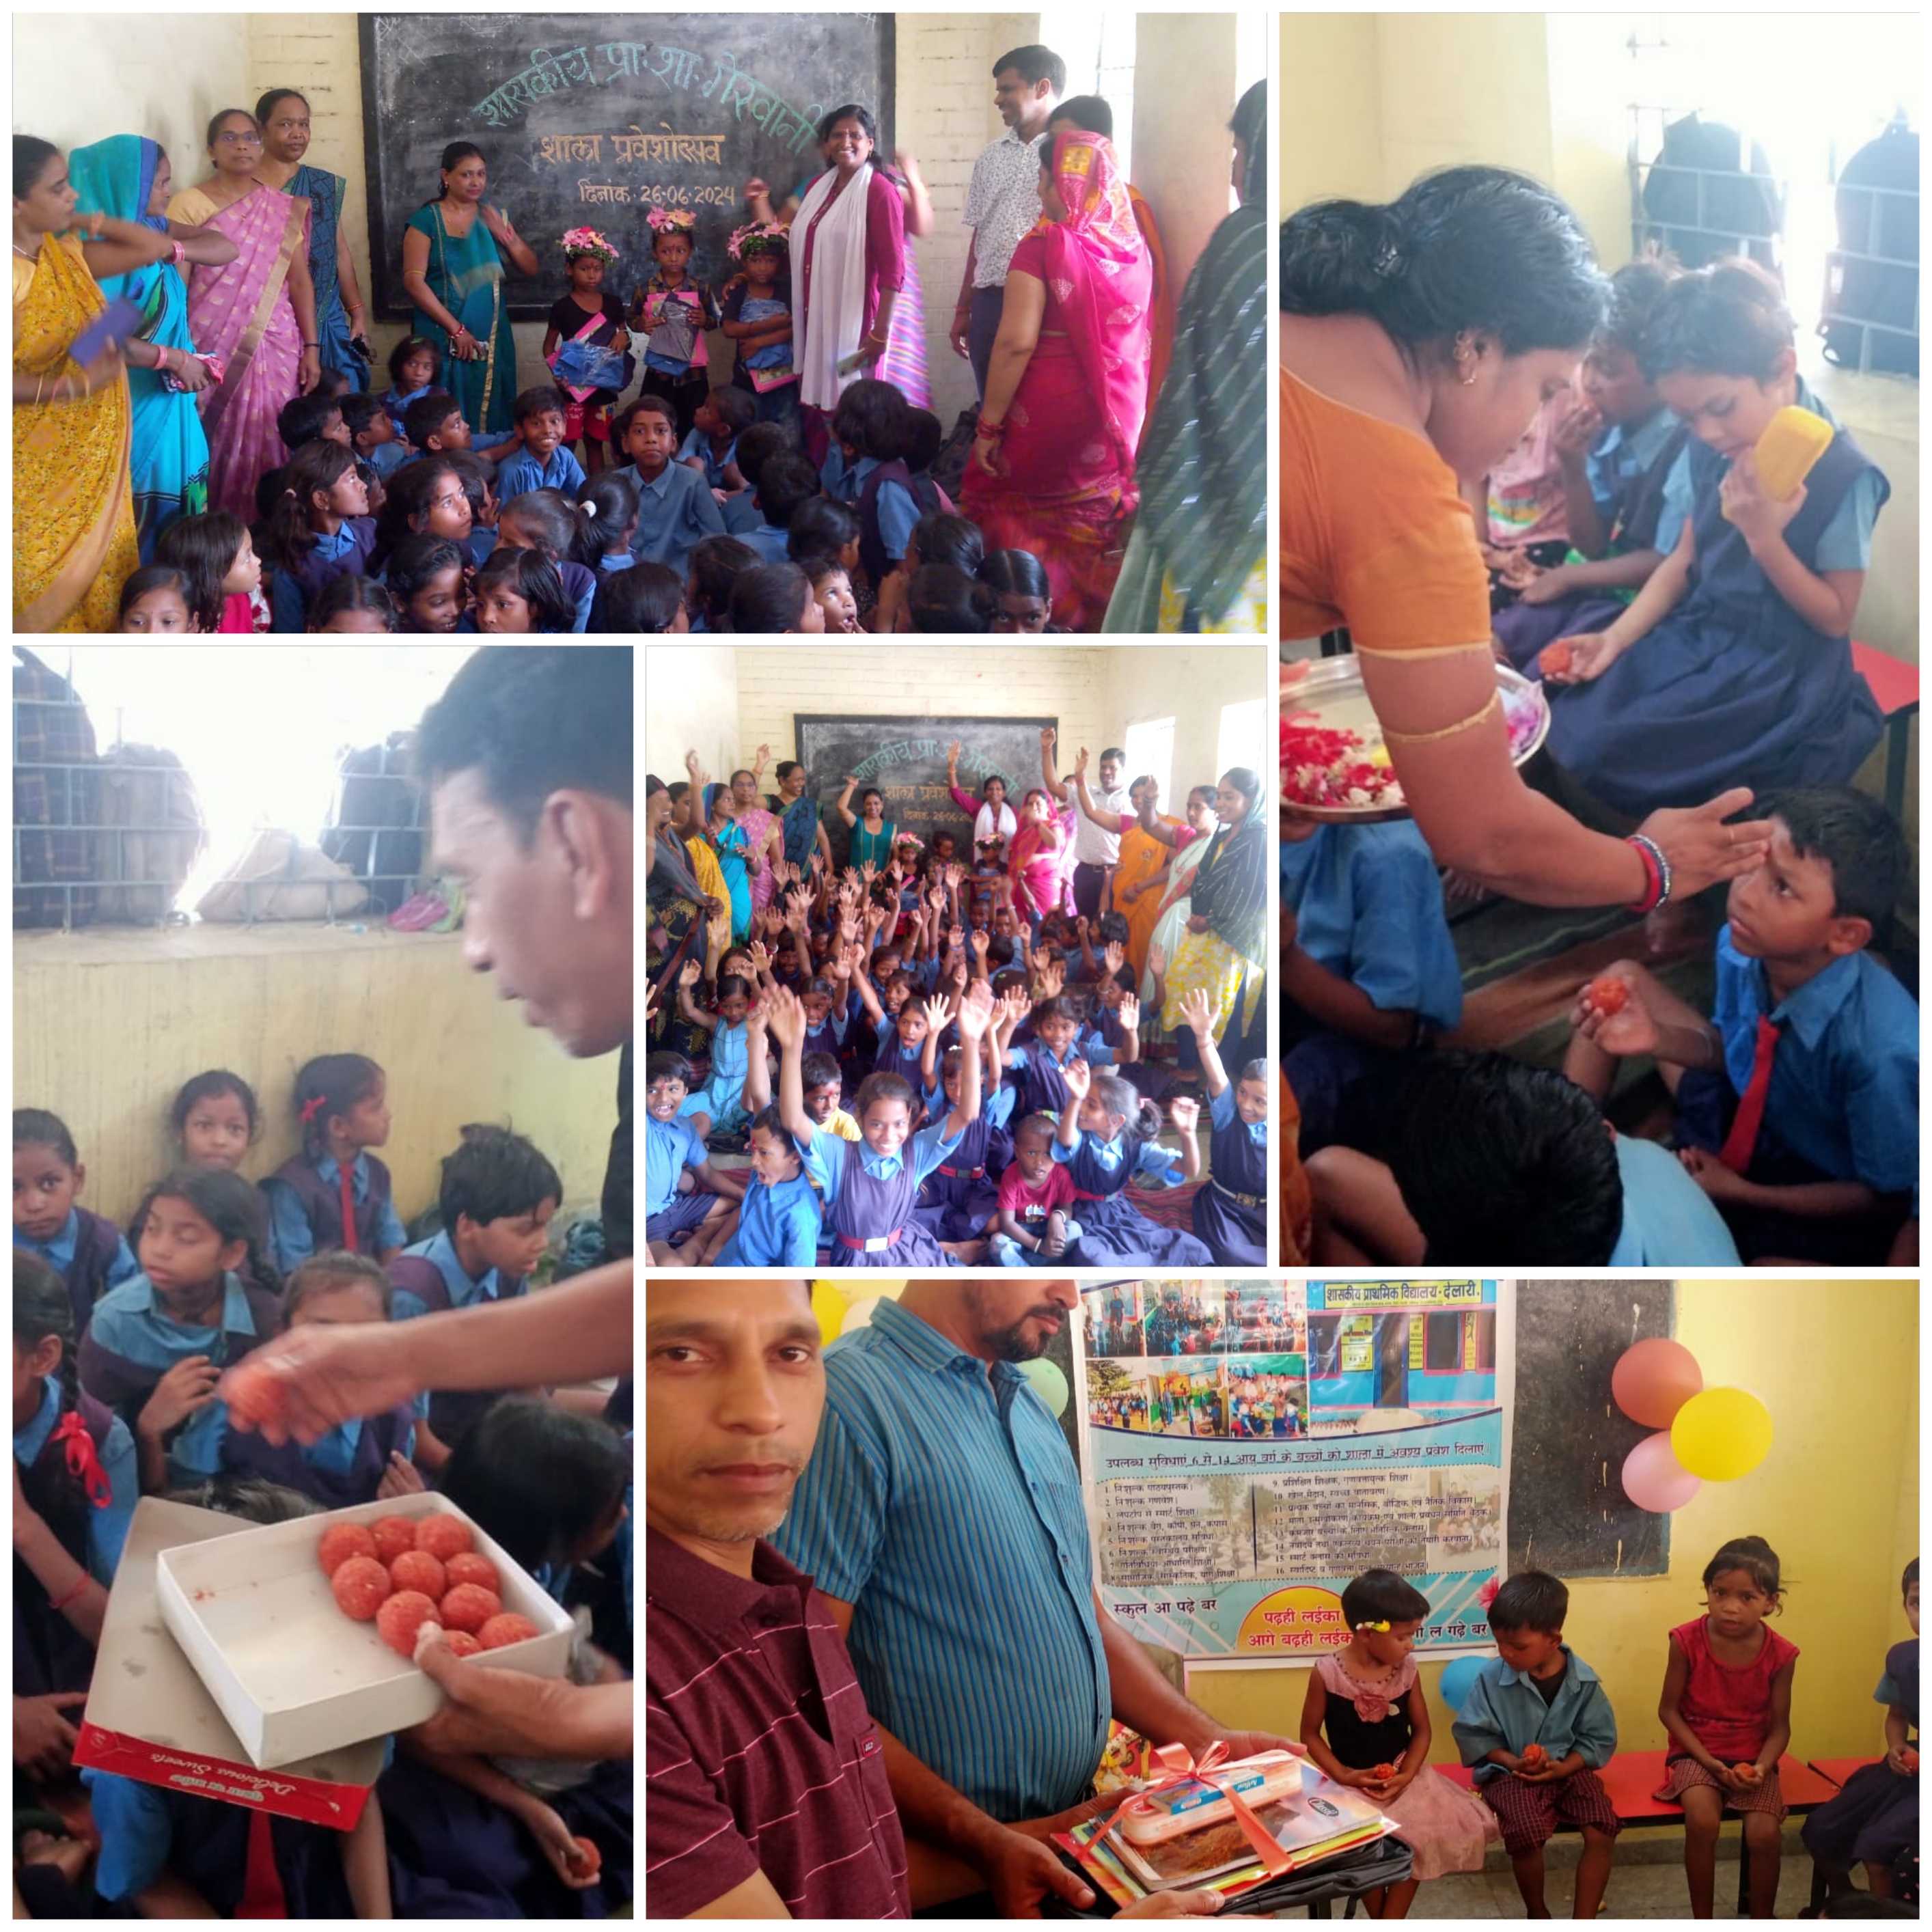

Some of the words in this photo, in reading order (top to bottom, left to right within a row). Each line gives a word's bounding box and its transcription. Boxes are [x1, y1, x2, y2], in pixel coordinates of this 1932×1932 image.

[470, 47, 596, 127] शासकीय
[540, 135, 603, 165] शाला
[611, 122, 726, 165] प्रवेशोत्सव
[885, 786, 916, 801] शाला
[1327, 1284, 1360, 1301] शासकीय
[1364, 1282, 1398, 1300] प्राथमिक
[1105, 1458, 1143, 1468] उपलब्ध
[1148, 1453, 1187, 1470] सुविधाएं
[1191, 1456, 1198, 1465] 6
[1203, 1452, 1212, 1465] से
[1235, 1454, 1256, 1467] आयु
[1261, 1450, 1276, 1465] वर्ग
[1281, 1449, 1292, 1463] के
[1297, 1448, 1323, 1462] बच्चों
[1327, 1447, 1341, 1461] को
[1346, 1449, 1372, 1460] शाला
[1390, 1447, 1421, 1458] अवश्य
[1426, 1443, 1449, 1456] प्रवेश
[1154, 1602, 1171, 1613] आ
[1201, 1599, 1218, 1611] बर
[1302, 1607, 1340, 1624] लईका
[1248, 1630, 1275, 1646] आगे
[1319, 1629, 1353, 1645] लईक
[1471, 1623, 1487, 1635] बर
